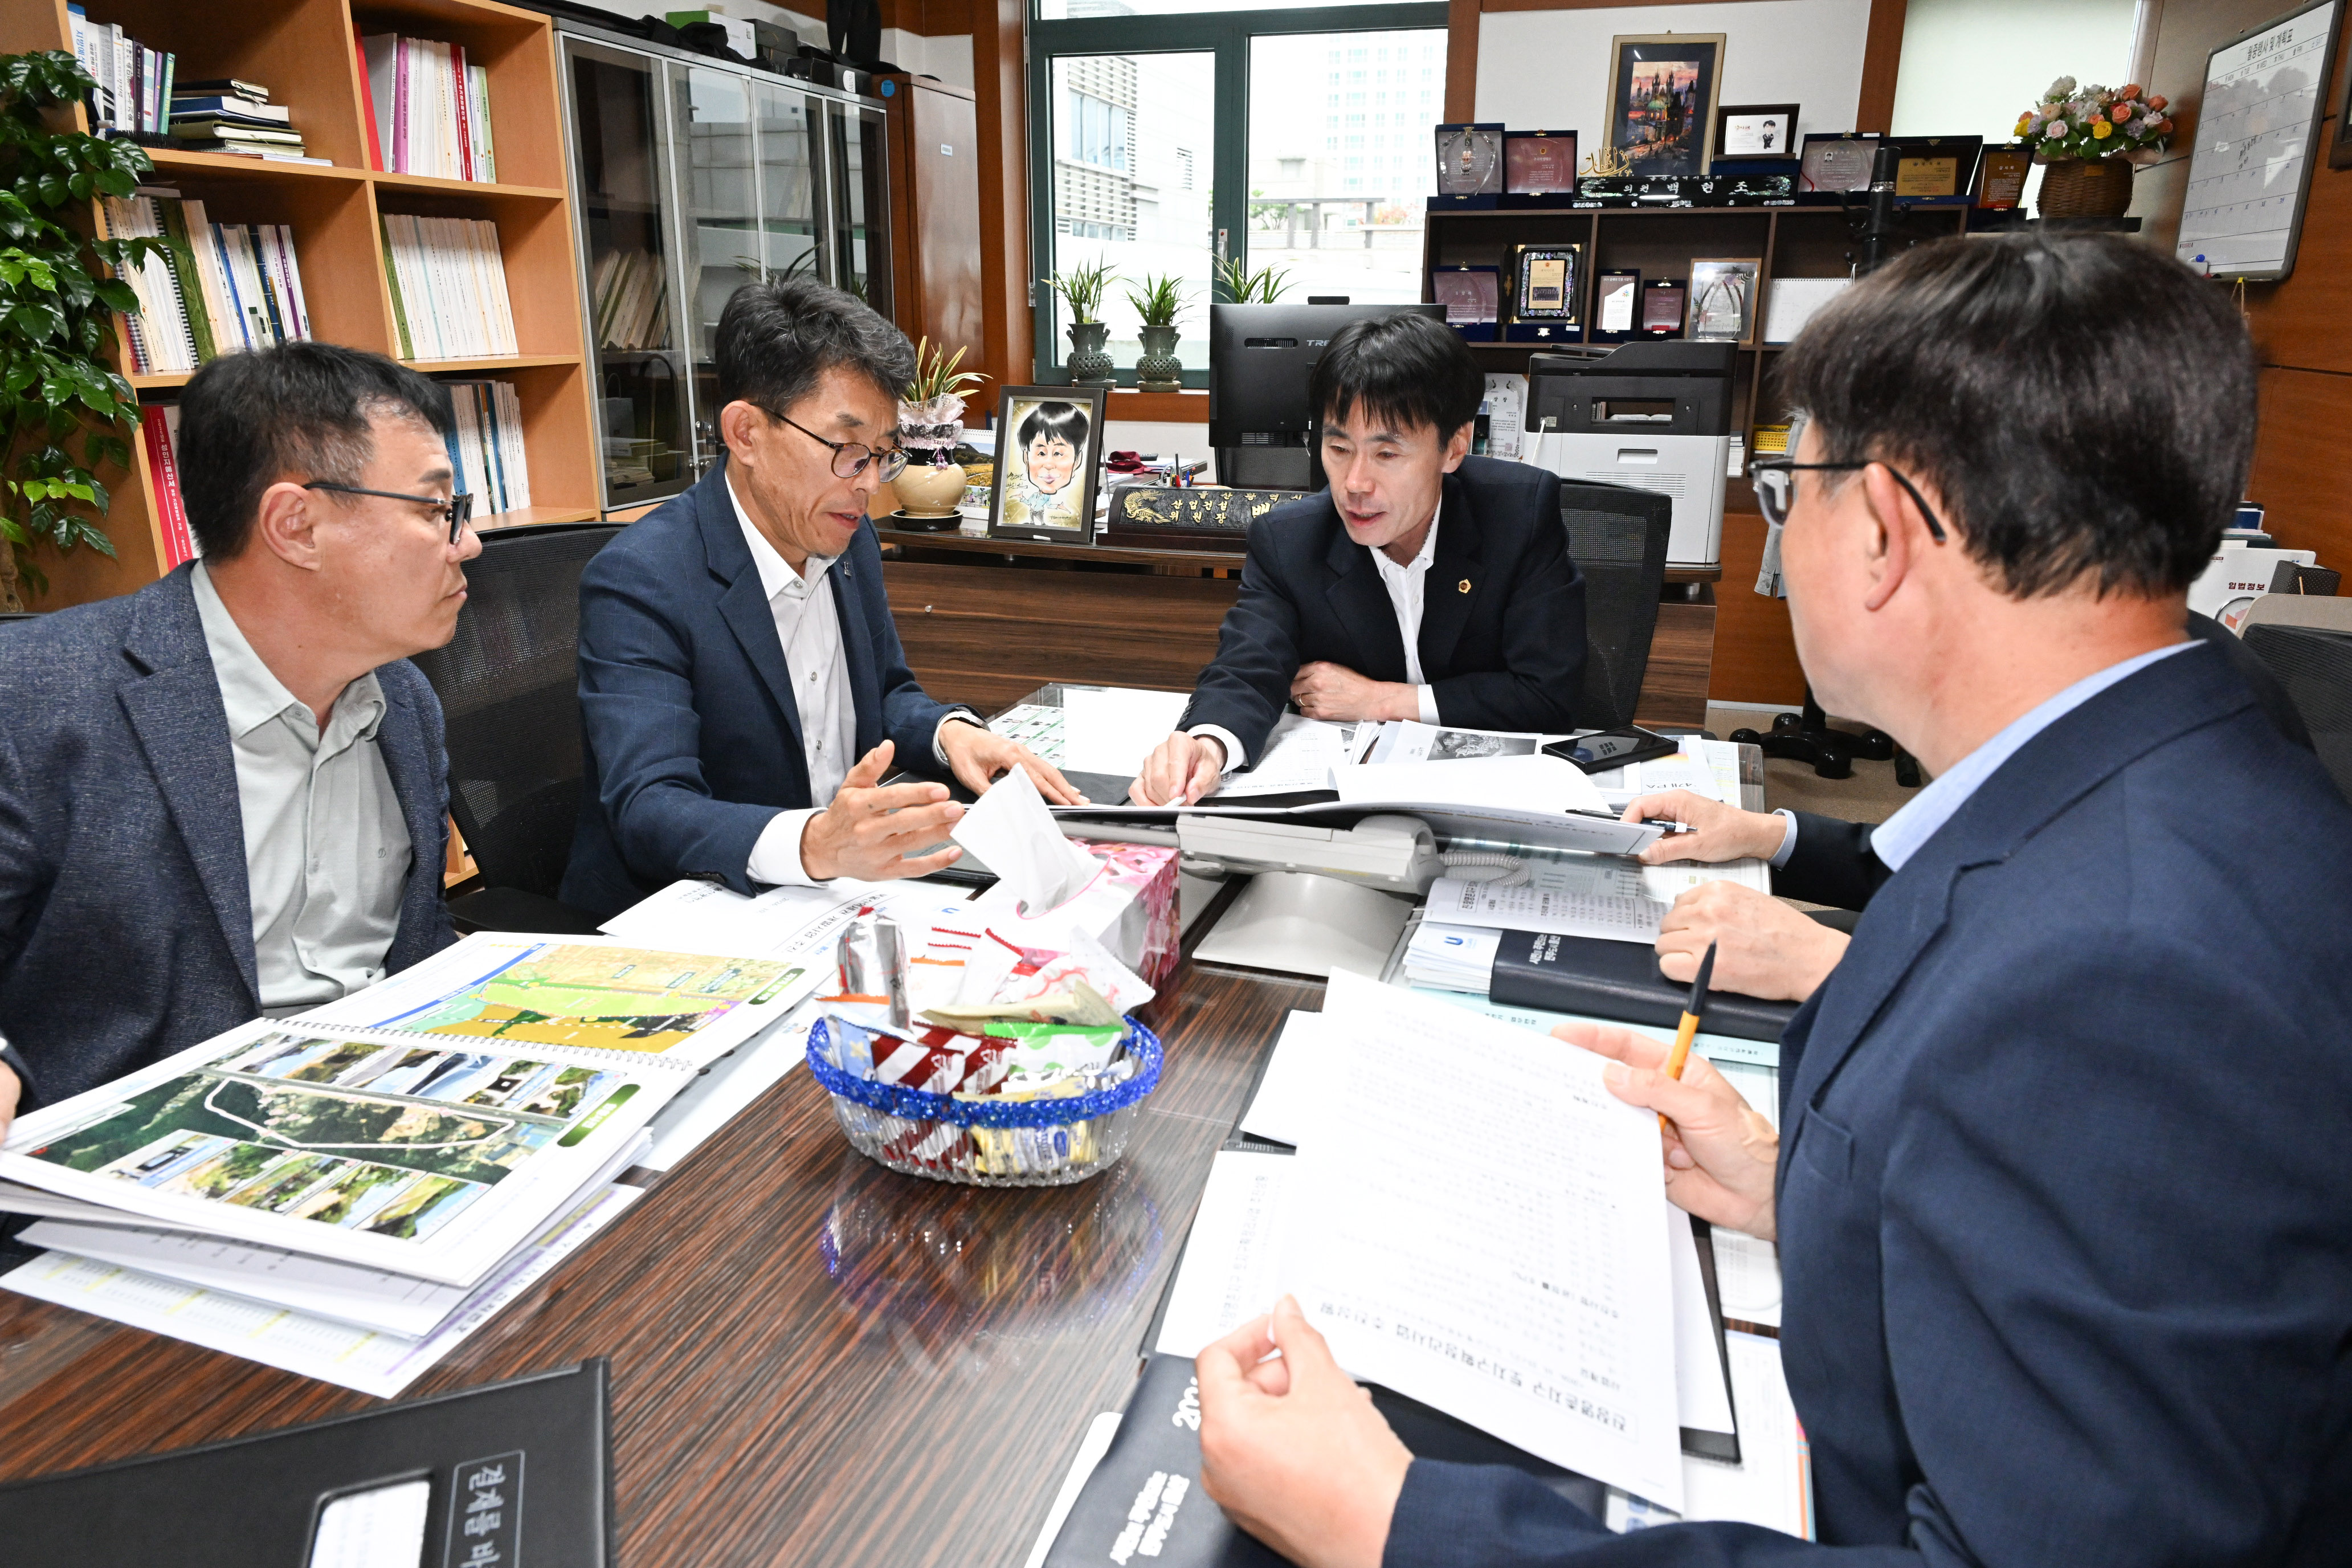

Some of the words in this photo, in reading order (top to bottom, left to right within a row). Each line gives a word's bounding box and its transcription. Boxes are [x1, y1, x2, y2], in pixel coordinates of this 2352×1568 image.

[2247, 38, 2269, 62] 월중행사
[1667, 182, 1748, 194] 백현조
[1198, 490, 1303, 501] 울산광역시
[1171, 500, 1228, 511] 산업건설
[1169, 511, 1227, 524] 위원장
[2228, 581, 2265, 591] 입법정보
[803, 915, 840, 938] 개발사업
[1393, 1325, 1525, 1387] 토지구획정리사업
[1532, 1381, 1627, 1433] 진장명촌지구
